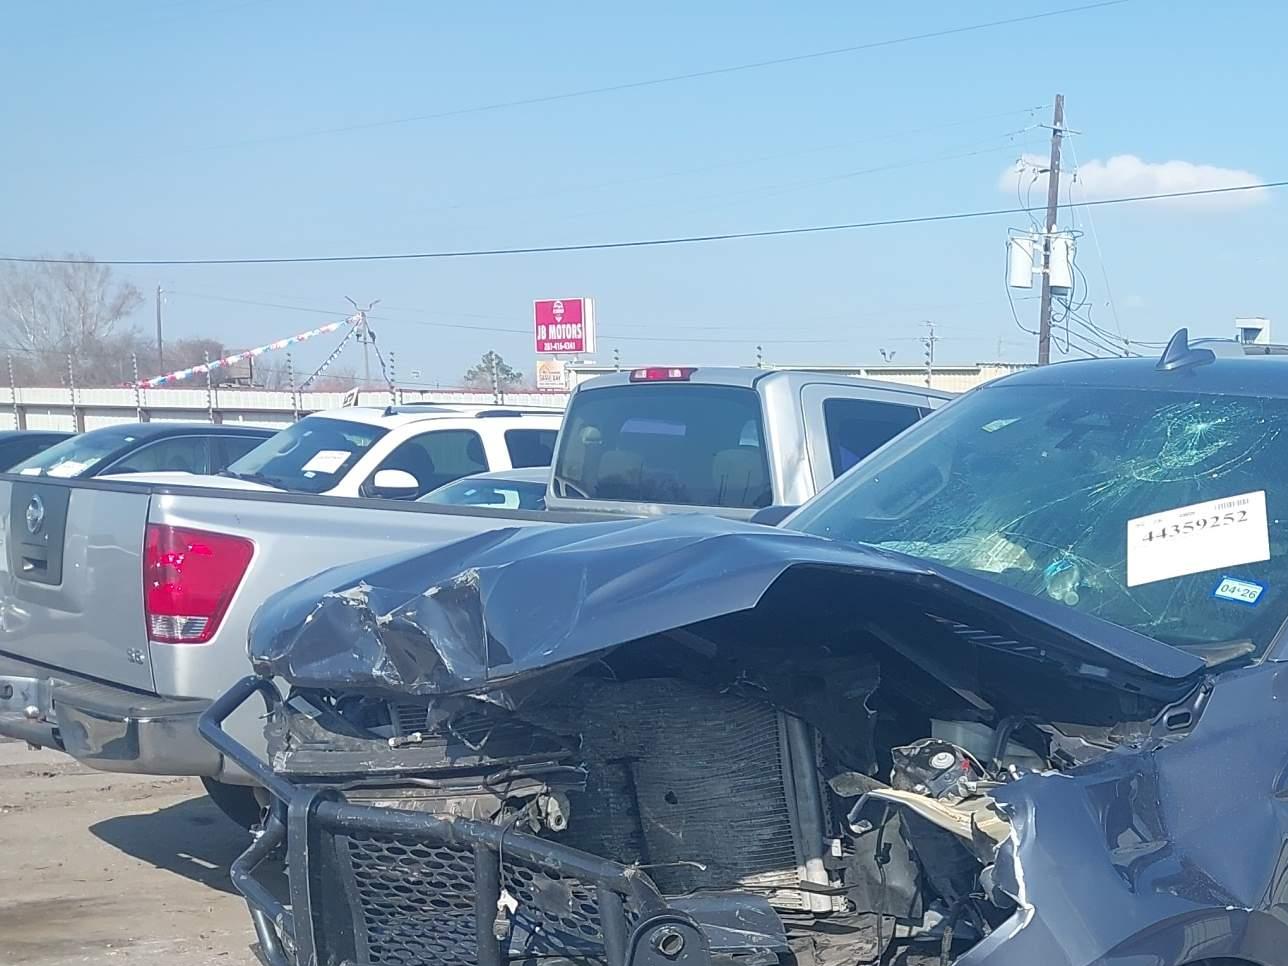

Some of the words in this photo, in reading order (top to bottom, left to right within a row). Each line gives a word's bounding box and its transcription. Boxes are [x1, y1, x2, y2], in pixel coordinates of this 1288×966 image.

[537, 324, 547, 341] JB
[548, 323, 582, 340] MOTORS
[1142, 510, 1248, 542] 44359252
